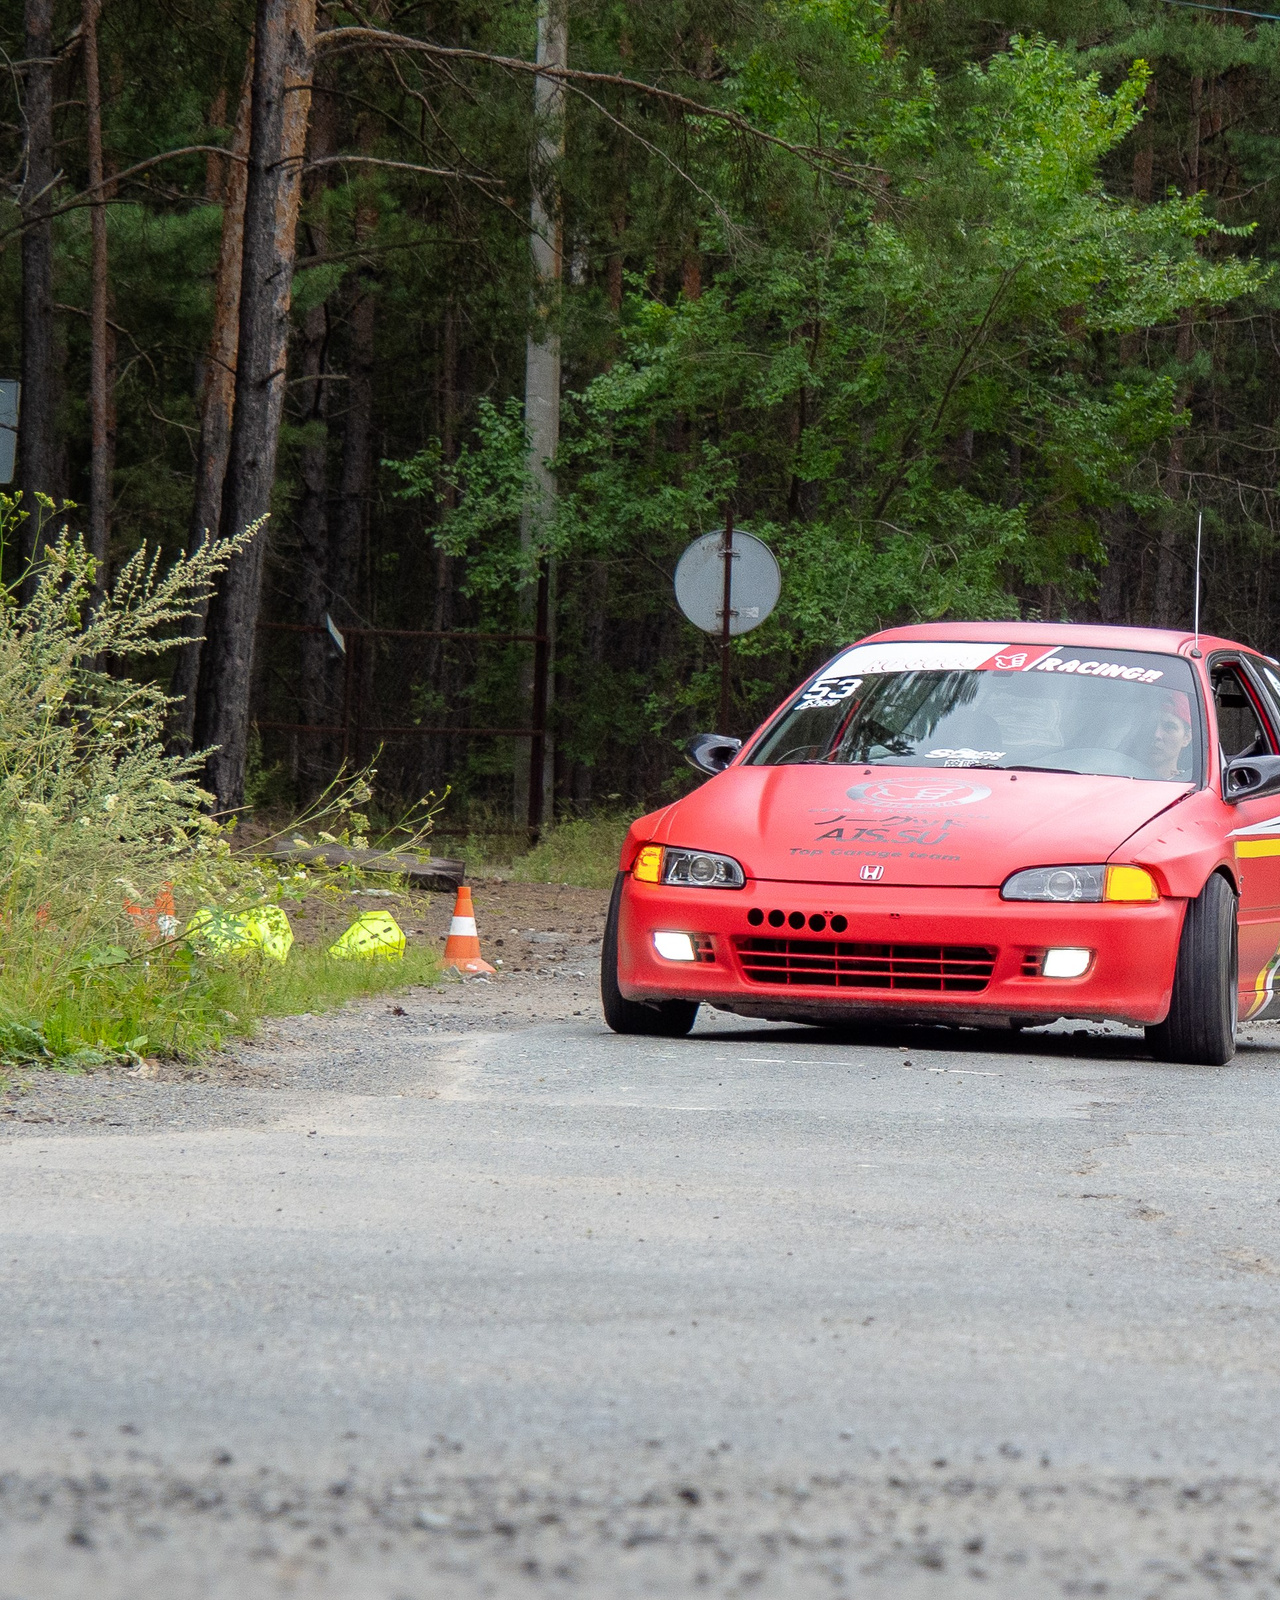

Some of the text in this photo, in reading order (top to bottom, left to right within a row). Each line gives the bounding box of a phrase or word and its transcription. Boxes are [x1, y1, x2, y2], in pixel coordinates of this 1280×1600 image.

[1036, 657, 1164, 683] RACING!!
[802, 679, 863, 699] 53
[814, 828, 950, 845] AJS.SU
[789, 848, 960, 861] Top Garage team
